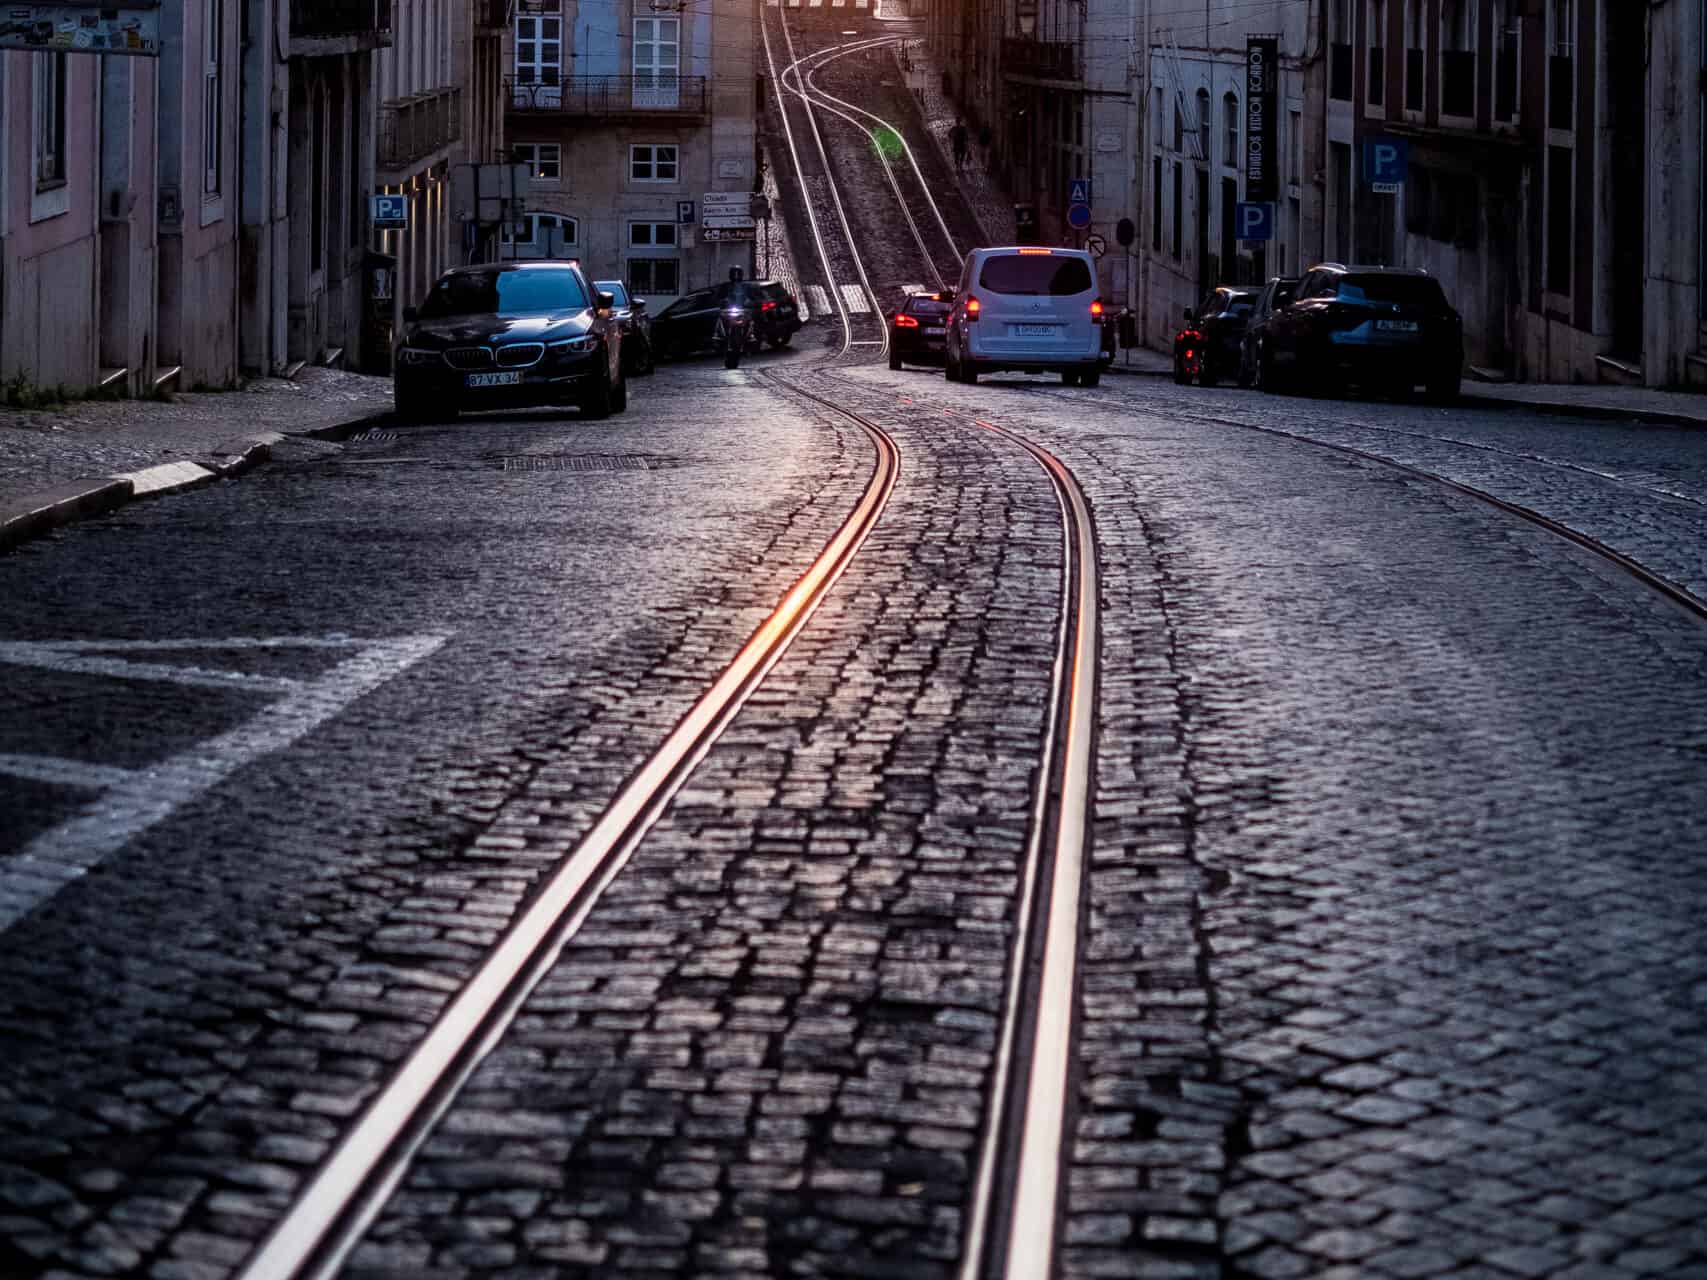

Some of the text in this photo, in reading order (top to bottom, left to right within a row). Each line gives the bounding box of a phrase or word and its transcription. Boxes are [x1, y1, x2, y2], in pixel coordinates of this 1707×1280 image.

[1375, 144, 1397, 175] P
[1072, 184, 1084, 200] A
[379, 200, 392, 218] P
[680, 203, 692, 222] P
[1243, 207, 1264, 236] P
